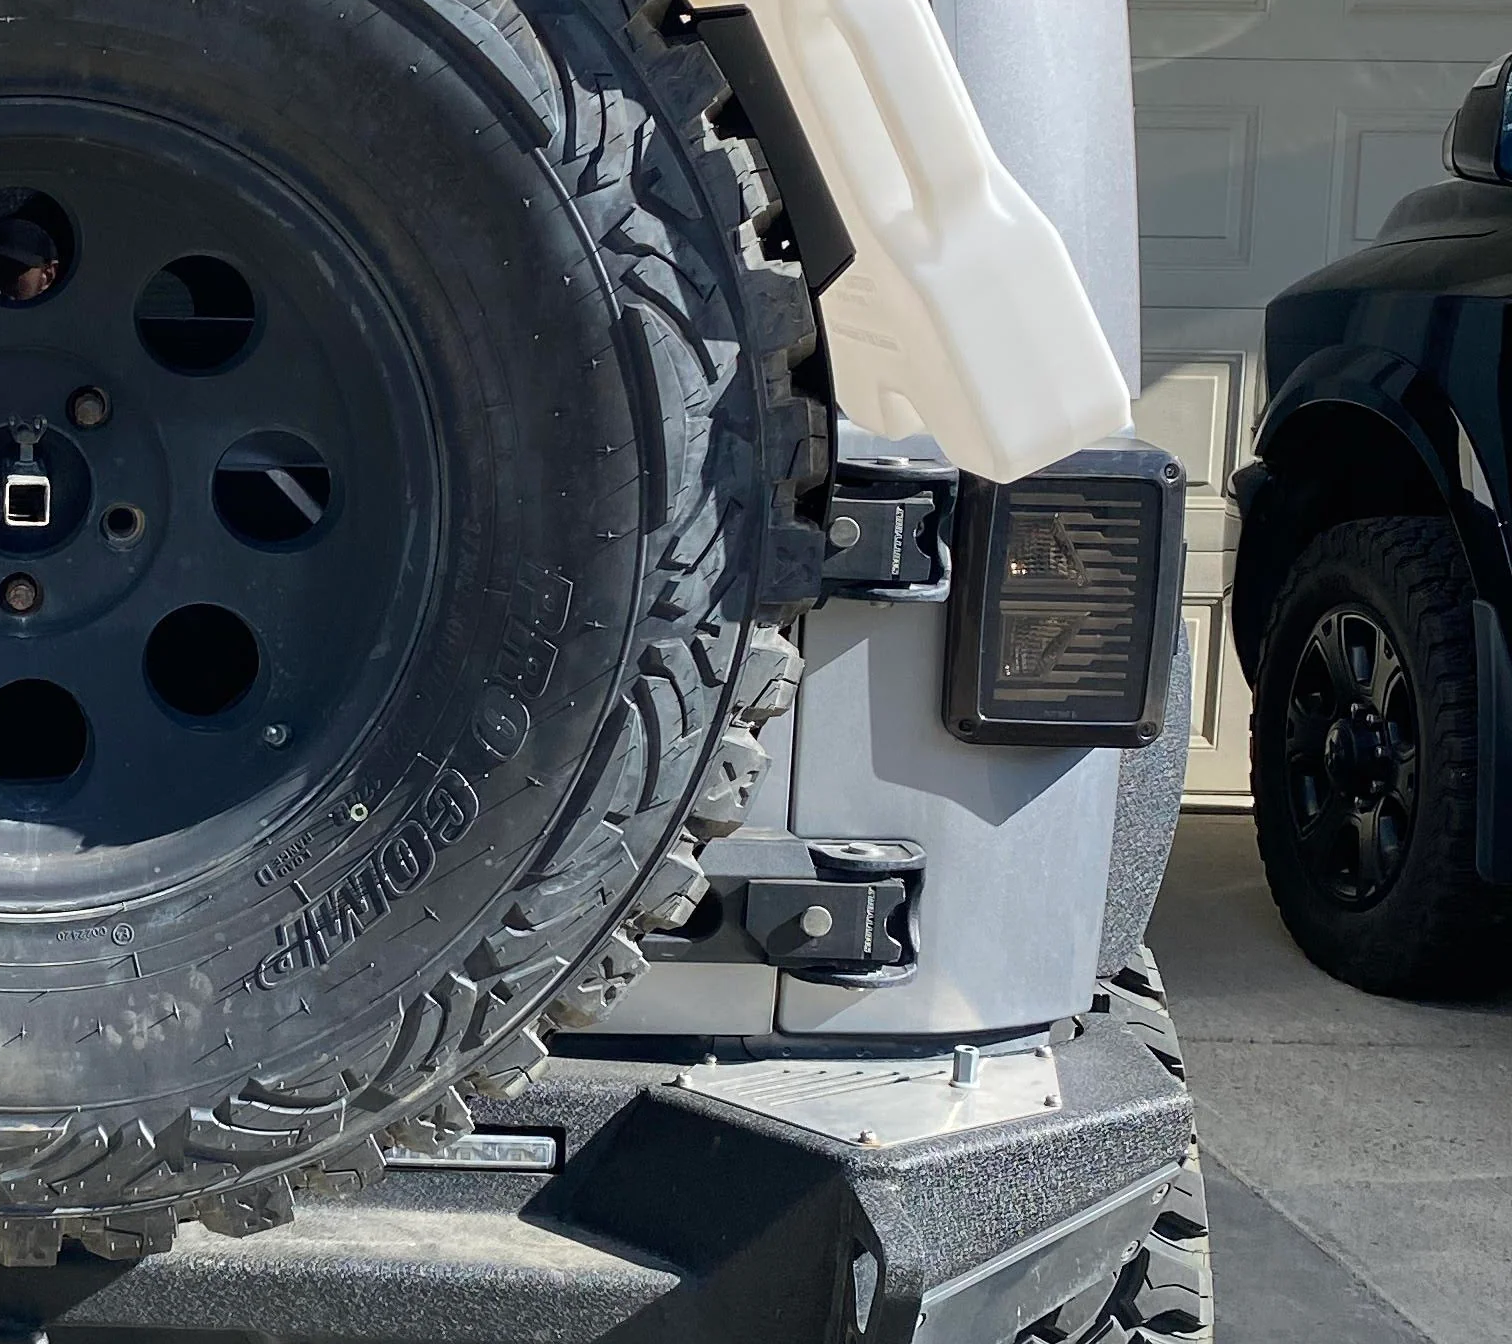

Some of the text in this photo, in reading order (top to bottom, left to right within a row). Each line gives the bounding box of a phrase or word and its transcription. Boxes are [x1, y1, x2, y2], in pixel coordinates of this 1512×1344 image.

[257, 562, 574, 989] PRO COMP
[275, 832, 314, 864] RANGE
[279, 848, 312, 877] LOAD
